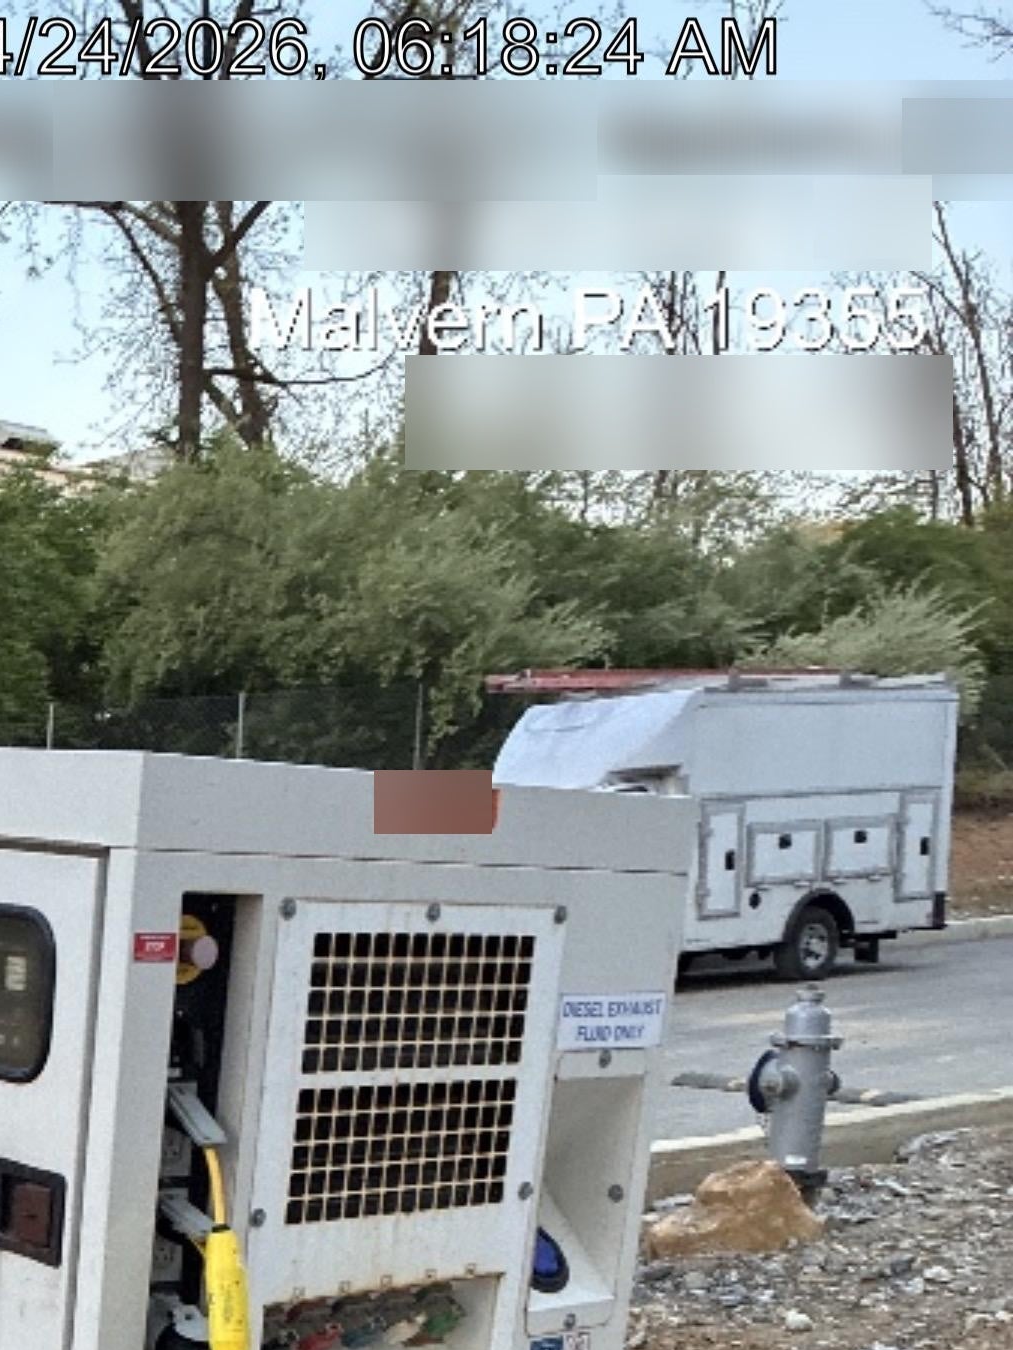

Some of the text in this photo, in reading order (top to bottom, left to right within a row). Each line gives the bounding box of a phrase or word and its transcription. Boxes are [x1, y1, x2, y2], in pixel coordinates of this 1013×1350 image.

[563, 999, 663, 1018] DIESEL EXHAUST
[575, 1024, 645, 1042] FLUID ONLY
